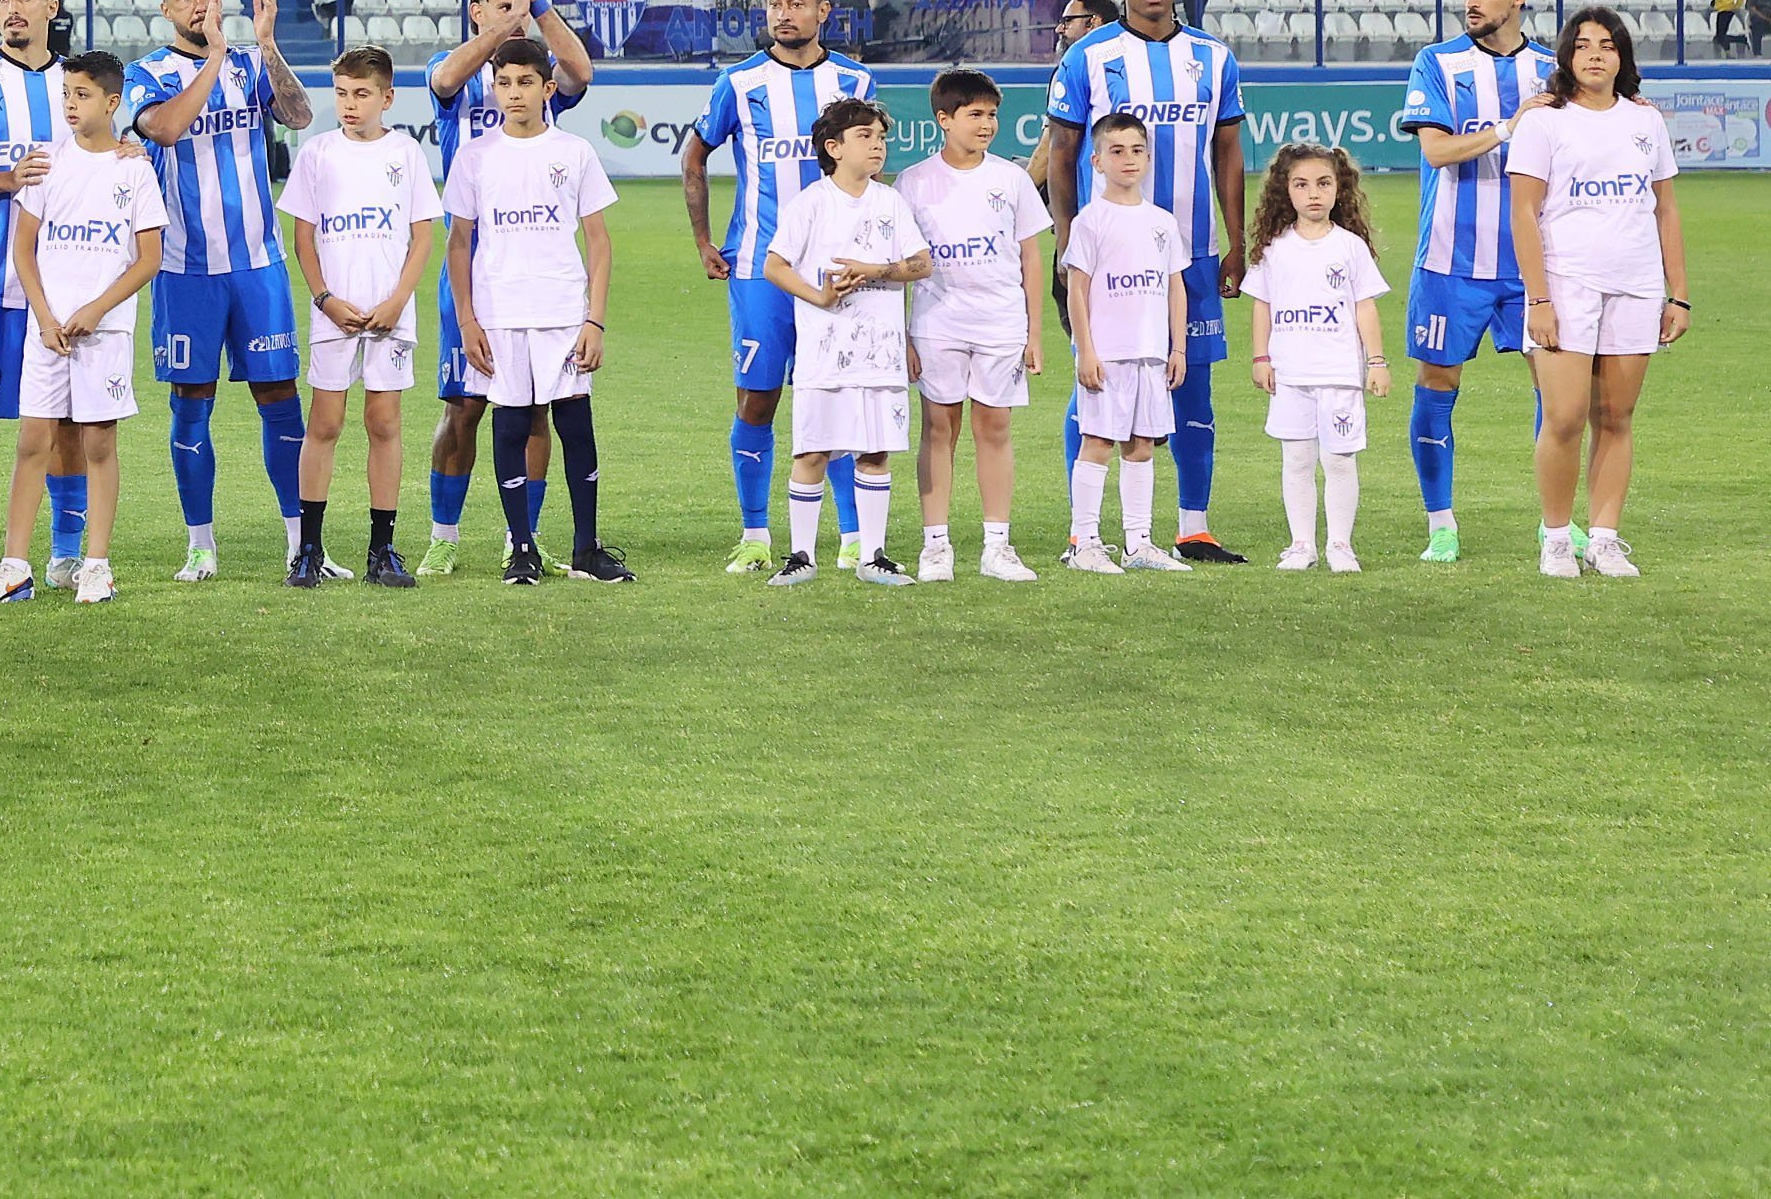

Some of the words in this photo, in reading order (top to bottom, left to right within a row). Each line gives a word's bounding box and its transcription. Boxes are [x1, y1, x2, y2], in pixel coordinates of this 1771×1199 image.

[190, 108, 258, 135] ONBET
[1570, 174, 1649, 197] IronFX
[321, 207, 393, 234] IronFX
[494, 205, 560, 226] IronFX
[1107, 270, 1164, 290] IronFX
[1427, 314, 1447, 351] 11
[167, 334, 191, 370] 10
[742, 338, 760, 373] 7
